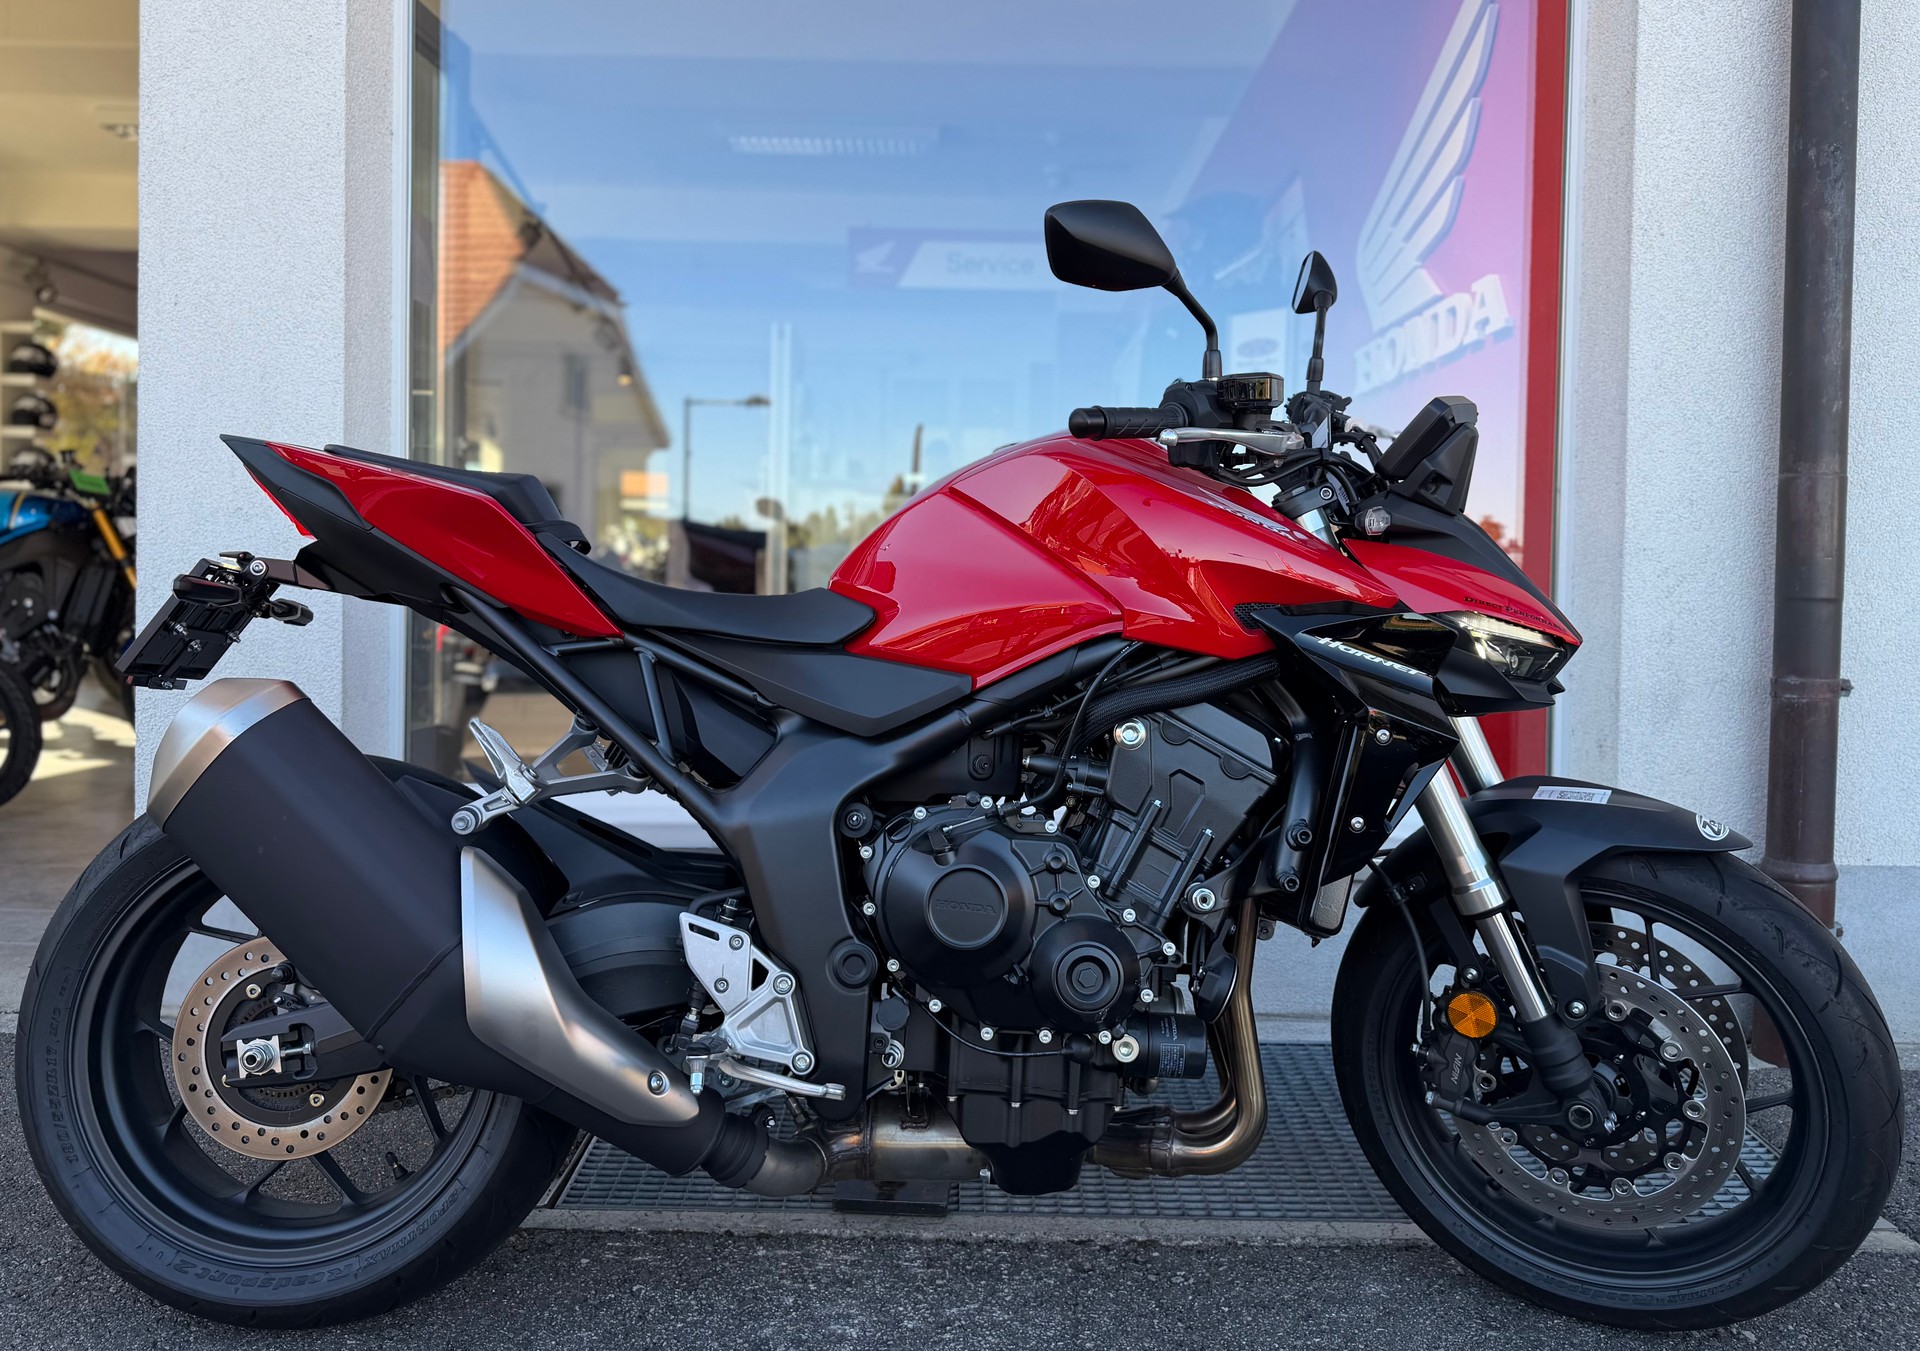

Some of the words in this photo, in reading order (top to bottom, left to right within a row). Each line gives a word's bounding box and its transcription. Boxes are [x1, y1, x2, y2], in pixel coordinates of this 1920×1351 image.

[945, 251, 1036, 276] Service
[1353, 273, 1513, 397] HONDA
[935, 898, 998, 916] HONDA
